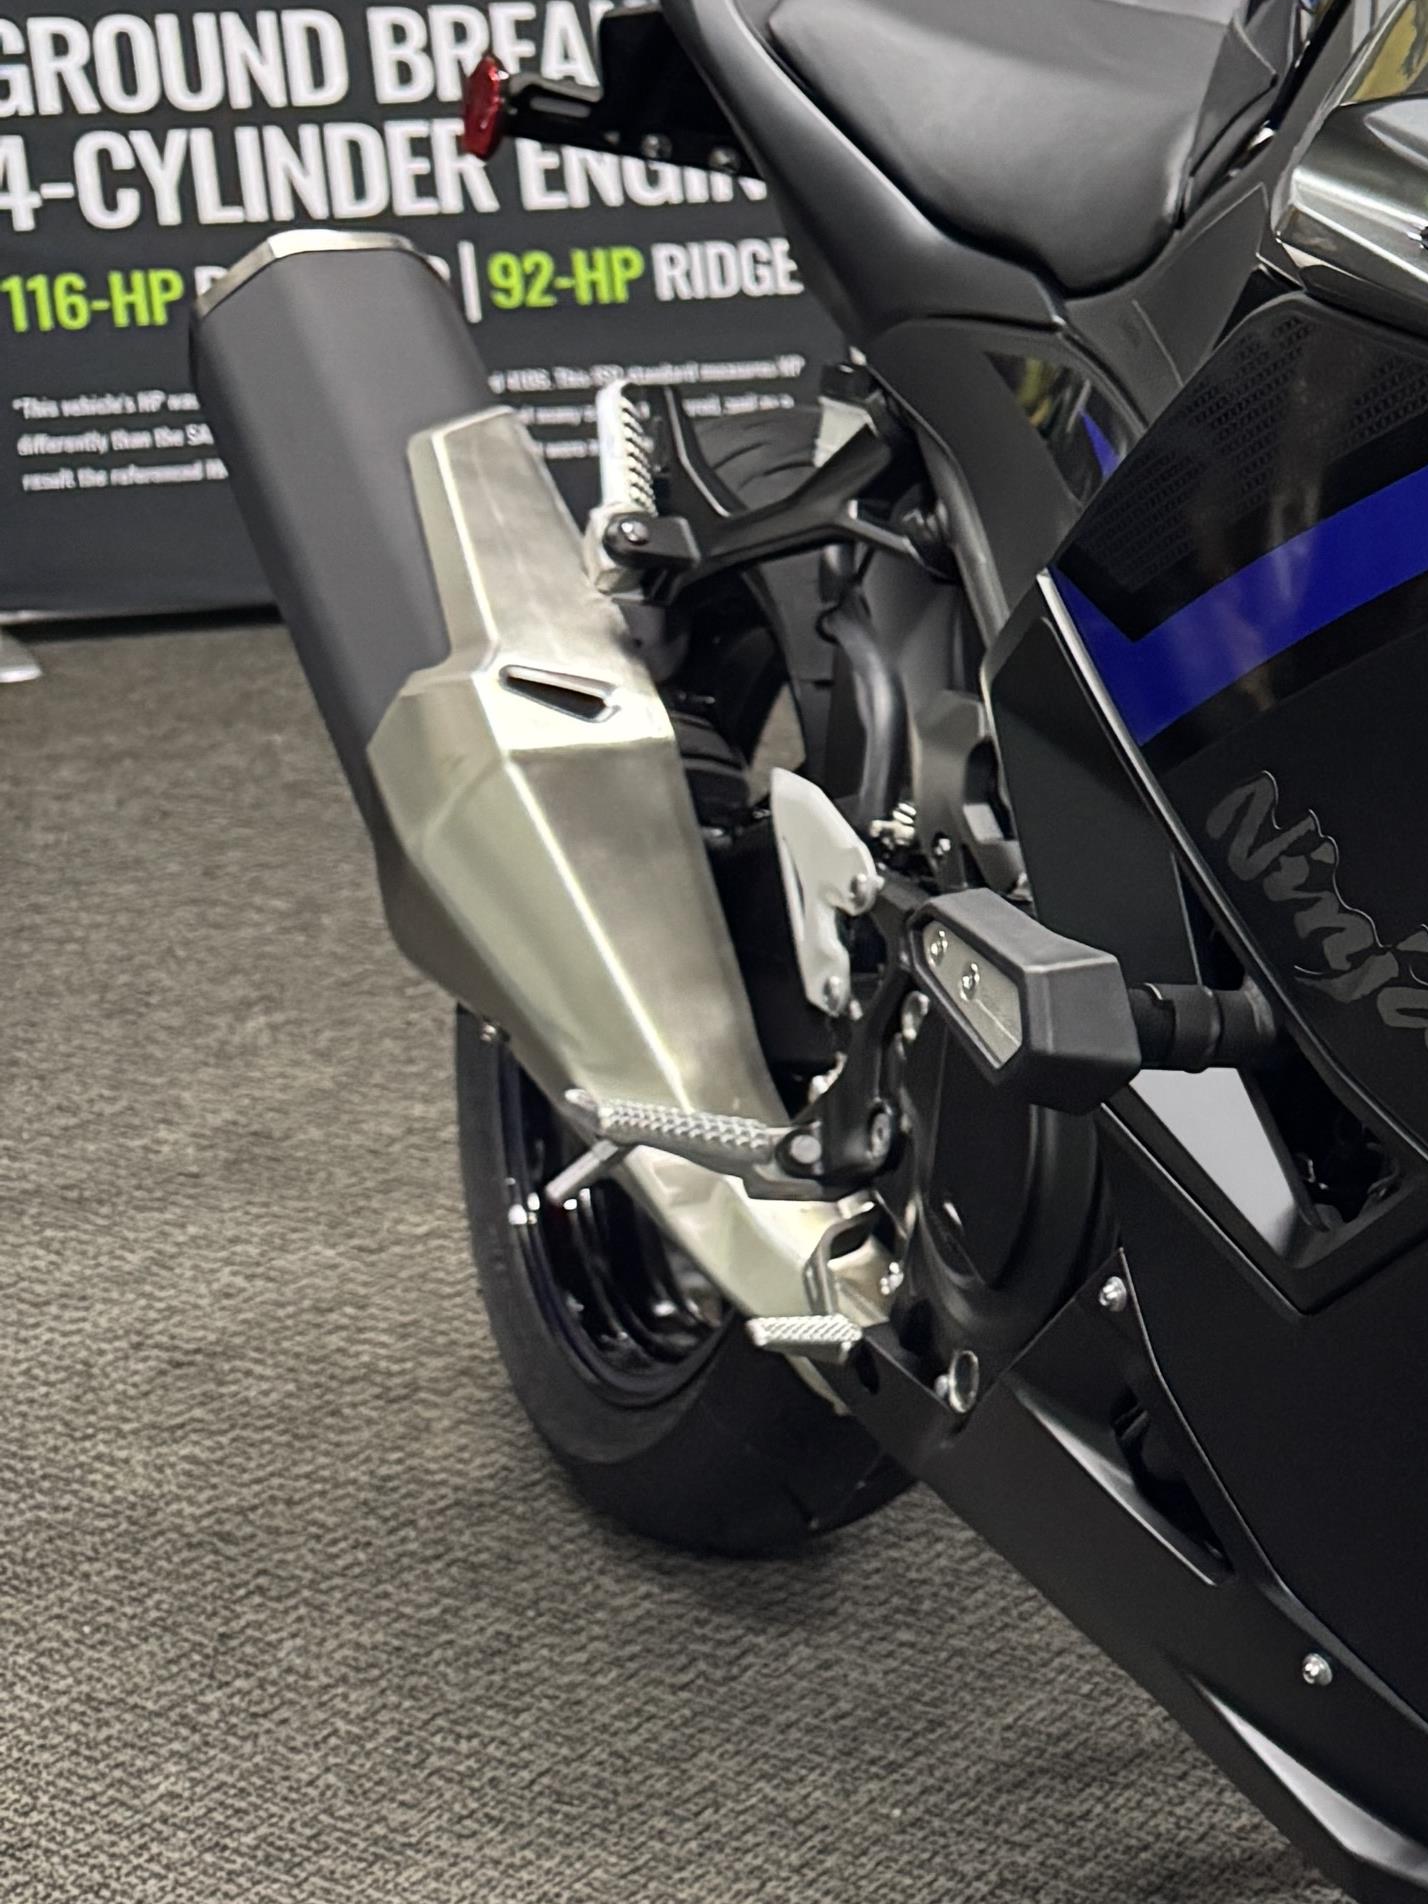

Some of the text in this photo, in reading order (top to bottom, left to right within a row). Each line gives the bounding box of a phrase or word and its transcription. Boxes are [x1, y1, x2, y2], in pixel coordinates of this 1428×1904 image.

[0, 117, 500, 232] 4-CYLINDER
[2, 267, 186, 334] 116-HP
[486, 246, 645, 310] 92-HP
[651, 238, 804, 302] RIDGE
